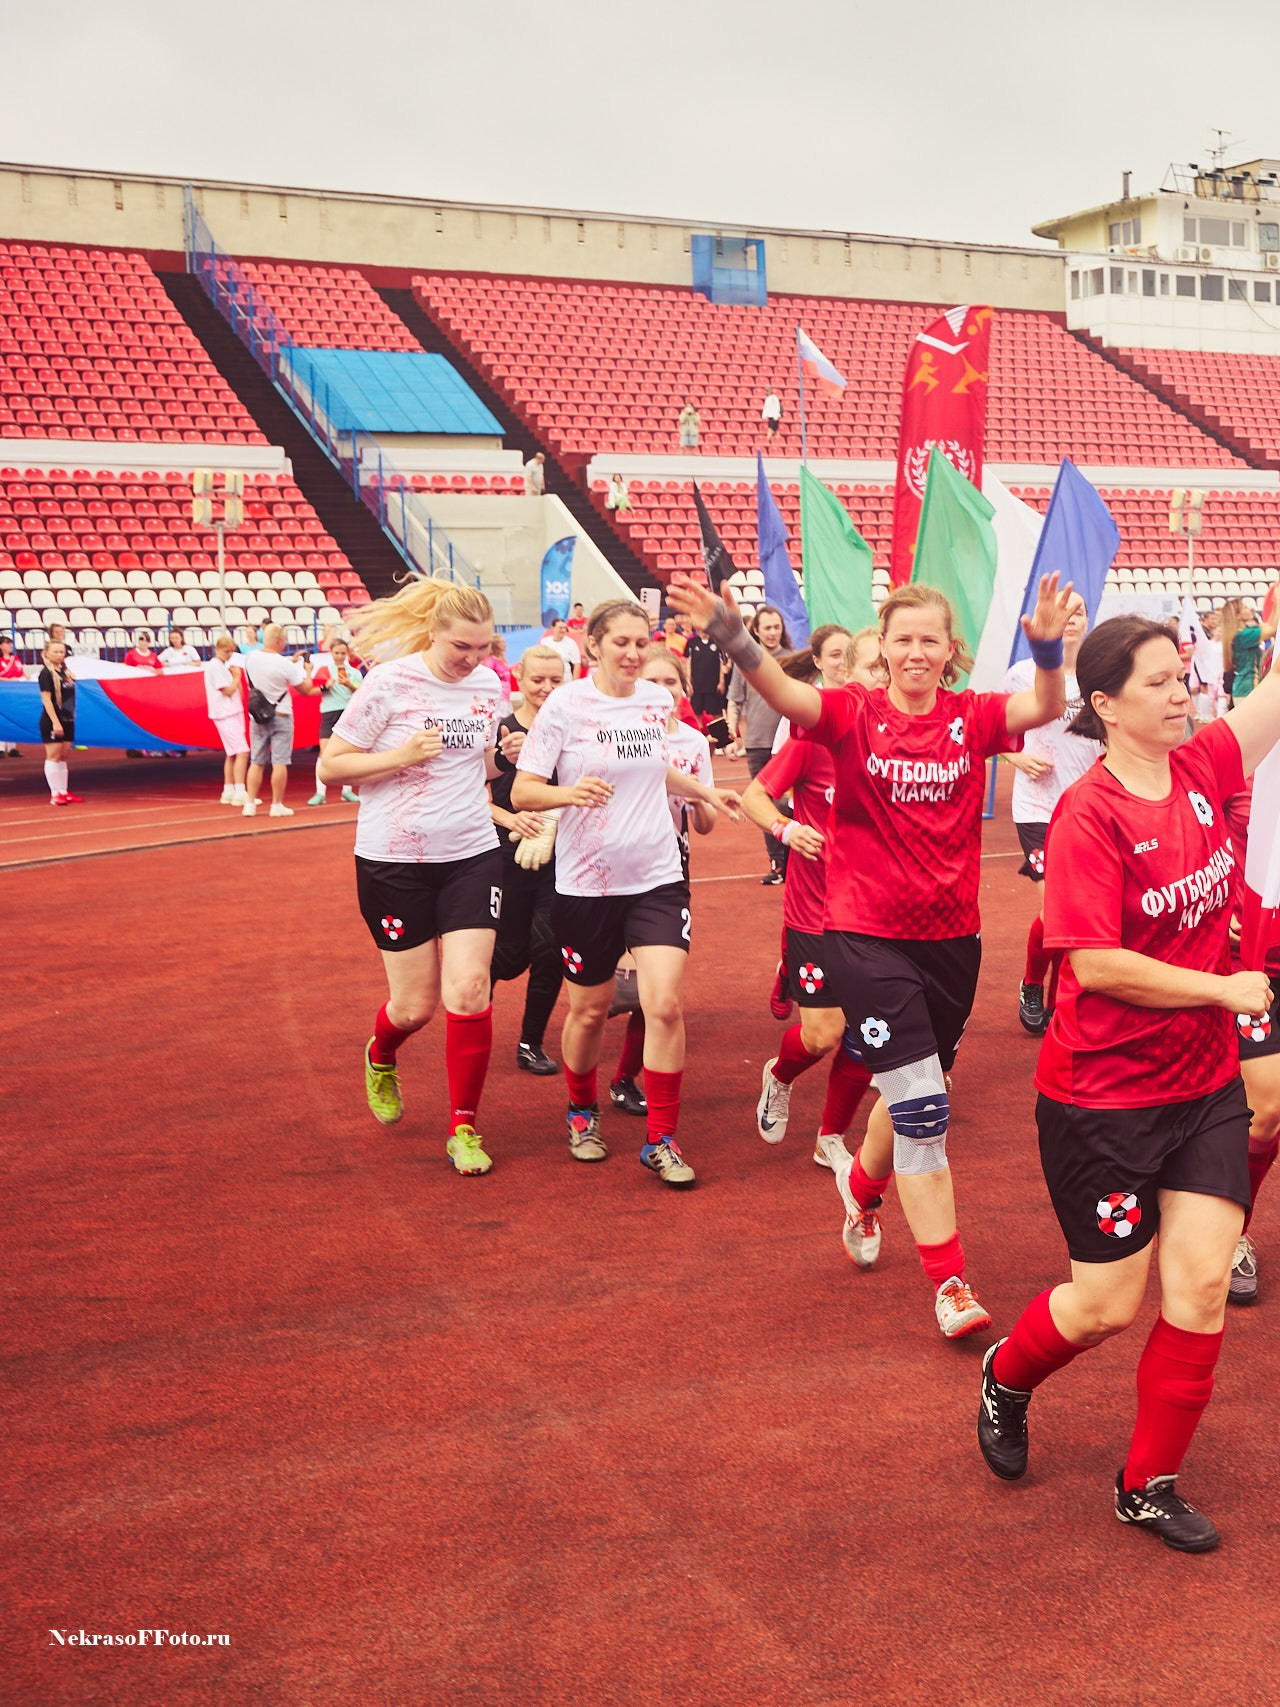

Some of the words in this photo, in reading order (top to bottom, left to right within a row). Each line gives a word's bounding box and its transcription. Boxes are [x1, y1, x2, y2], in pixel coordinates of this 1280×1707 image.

[596, 727, 663, 744] ФУТБОЛЬНАЯ
[616, 743, 653, 760] МАМА!
[891, 782, 955, 803] МАМА!
[680, 907, 692, 942] 2
